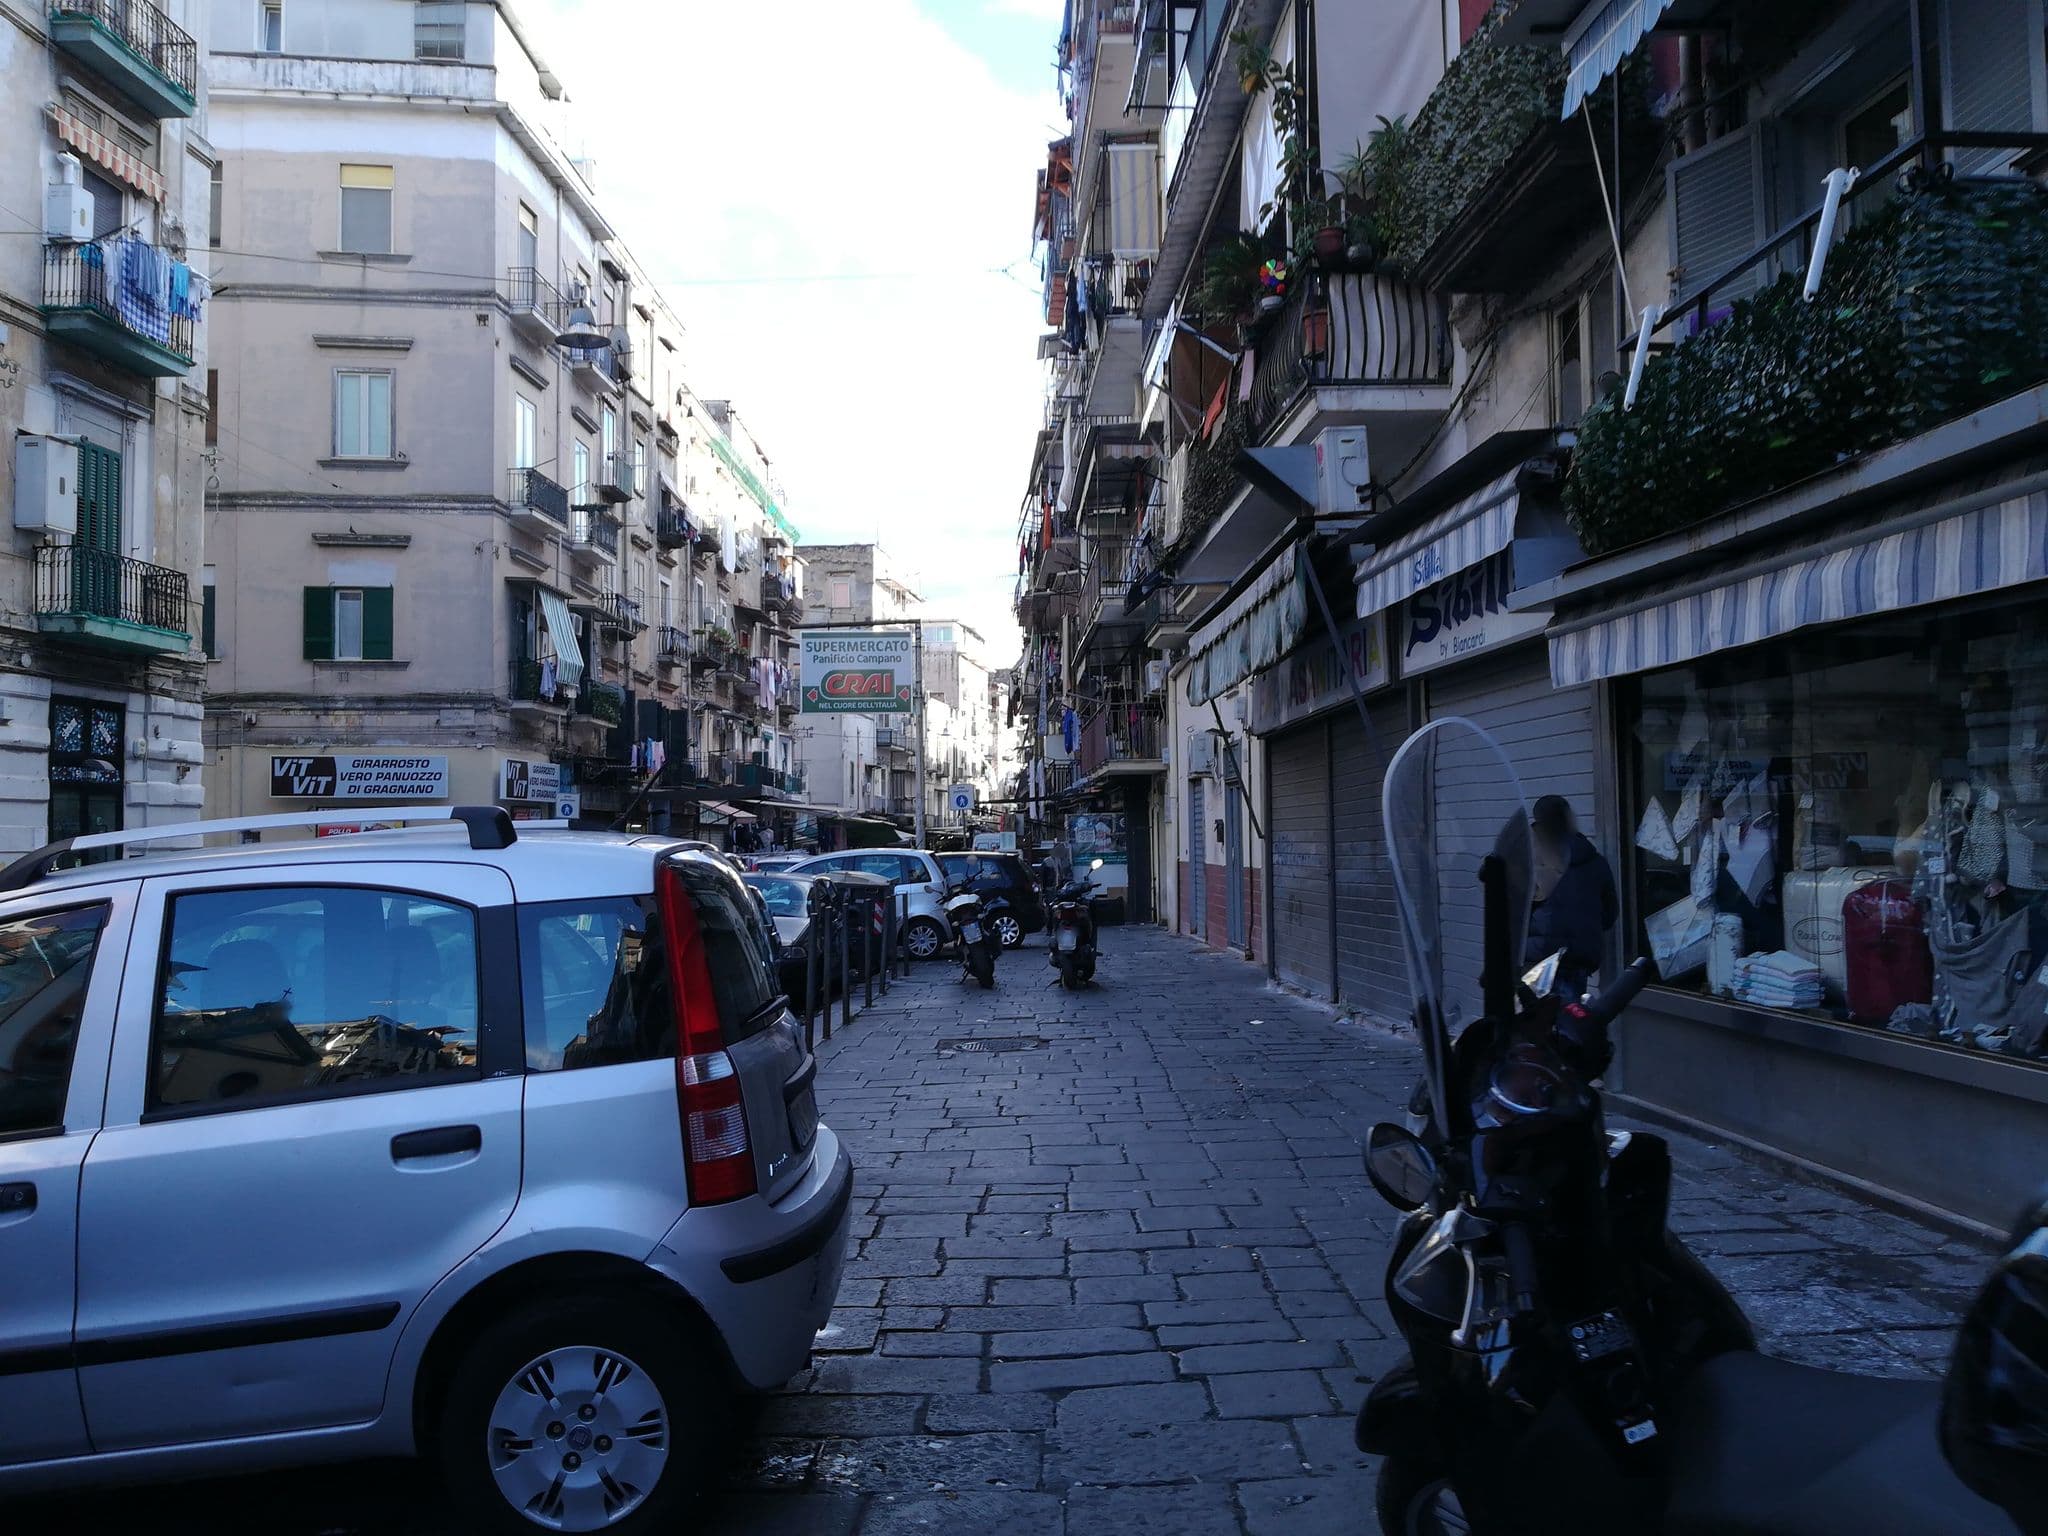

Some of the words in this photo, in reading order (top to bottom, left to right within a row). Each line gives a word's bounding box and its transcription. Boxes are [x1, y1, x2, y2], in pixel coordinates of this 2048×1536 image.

[1406, 551, 1516, 657] Sibill
[805, 640, 909, 653] SUPERMERCATO
[1440, 639, 1449, 658] by
[1453, 630, 1486, 654] Biancardi
[812, 654, 855, 664] Panificio
[856, 654, 902, 664] Campano
[825, 673, 892, 695] CRAI
[857, 701, 898, 709] DELL'ITALIA
[351, 759, 430, 769] GIRARROSTO
[340, 771, 373, 781] VERO
[375, 771, 442, 781] PANUOZZO
[347, 784, 361, 794] DI
[363, 784, 434, 794] GRAGNANO
